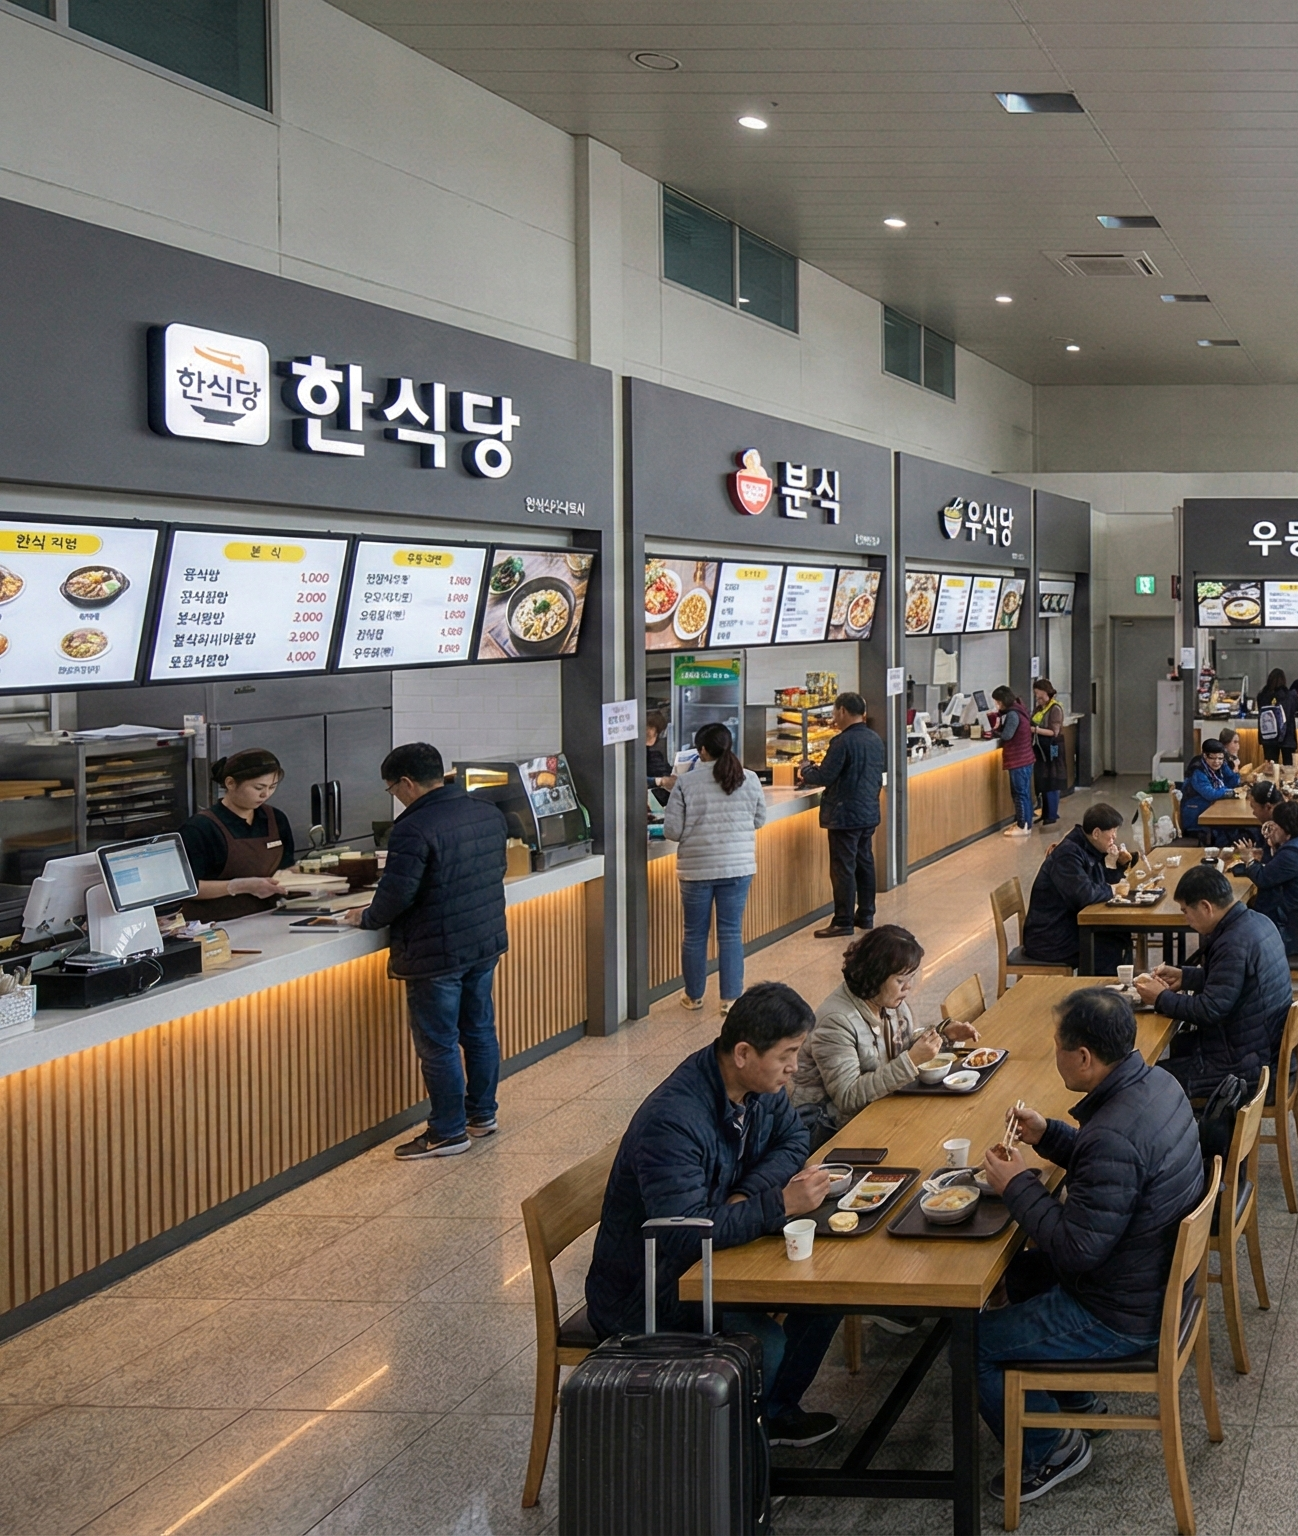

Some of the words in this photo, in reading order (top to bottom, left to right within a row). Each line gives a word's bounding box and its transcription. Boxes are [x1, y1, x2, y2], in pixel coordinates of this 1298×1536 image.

[176, 366, 262, 412] 한식당
[291, 354, 521, 479] 한식당
[781, 461, 840, 525] 분식
[965, 501, 1015, 547] 우식당
